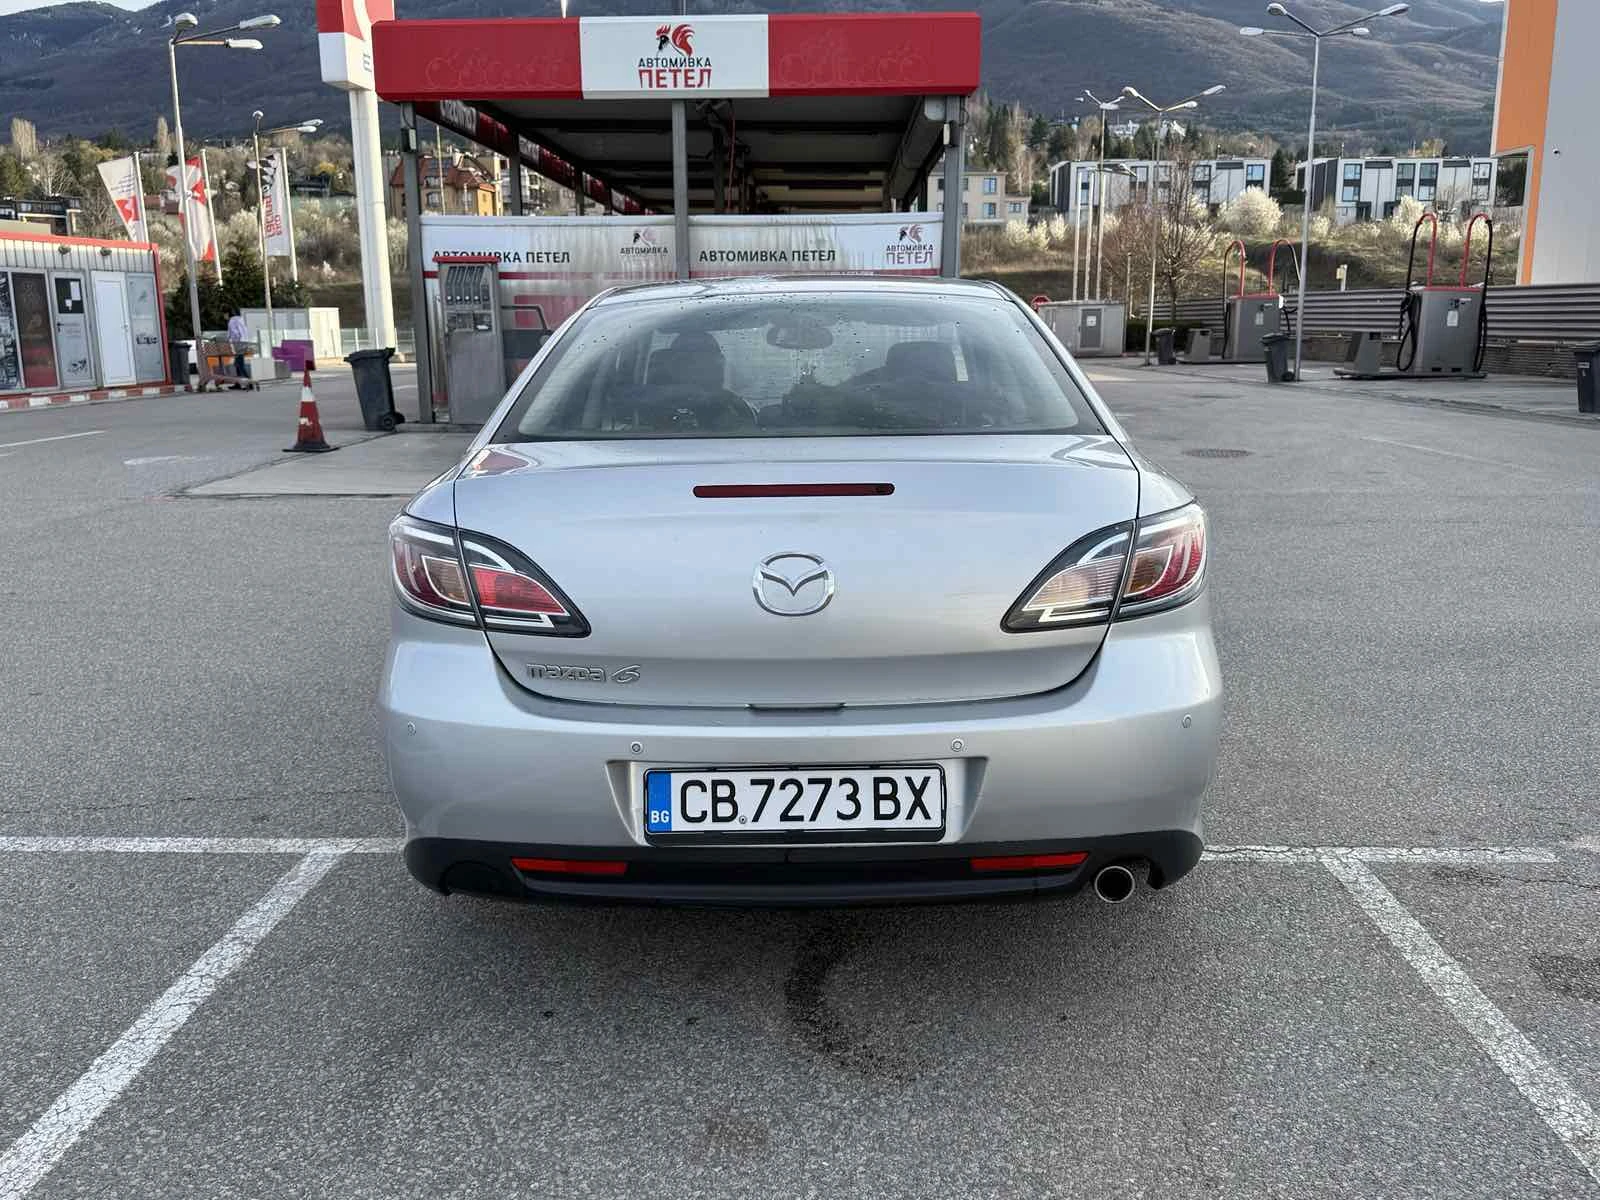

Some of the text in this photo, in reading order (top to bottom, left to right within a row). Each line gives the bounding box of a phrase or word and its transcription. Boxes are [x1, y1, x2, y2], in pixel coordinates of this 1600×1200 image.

[638, 57, 712, 67] АВТОМИВКА
[638, 68, 712, 88] ПЕТЕЛ
[886, 244, 933, 252] АВТОМИВКА
[526, 251, 571, 263] ПЕТЕЛ
[699, 250, 836, 262] АВТОМИВКА ПЕТЕЛ
[887, 252, 933, 265] ПЕТЕЛ
[610, 664, 641, 683] 6
[651, 811, 670, 823] BG
